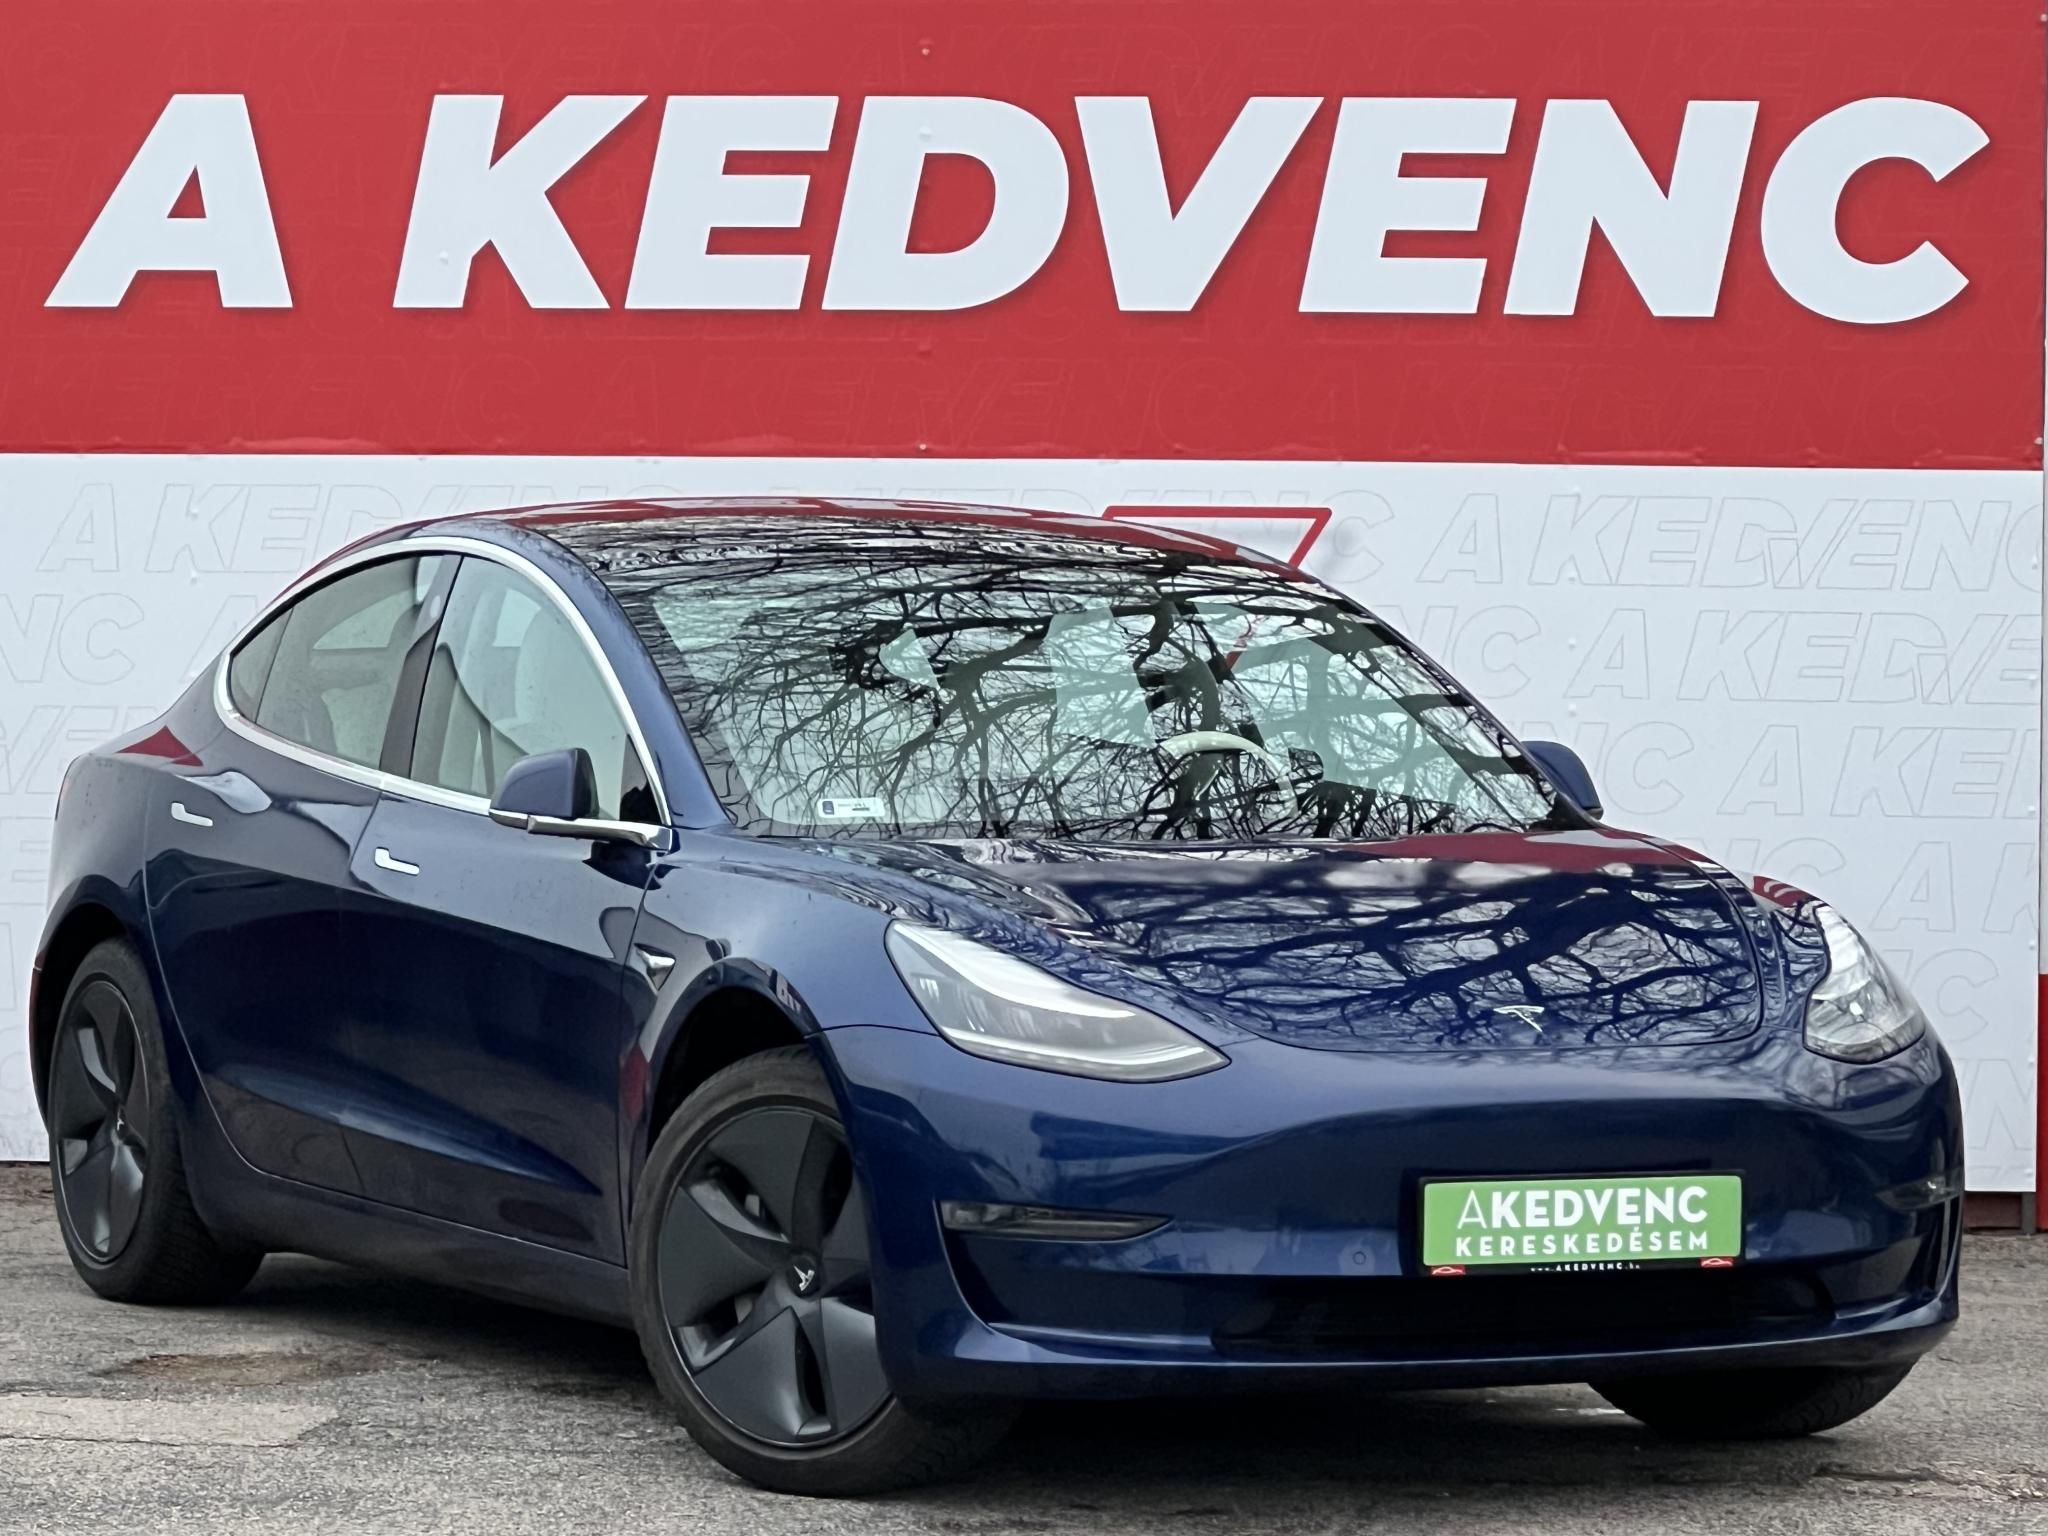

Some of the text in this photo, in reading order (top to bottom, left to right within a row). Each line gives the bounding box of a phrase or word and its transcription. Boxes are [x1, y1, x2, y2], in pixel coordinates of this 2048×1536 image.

[44, 93, 293, 309] A
[392, 93, 1992, 325] KEDVENC
[1455, 1226, 1709, 1258] KERESKEDÉSEM
